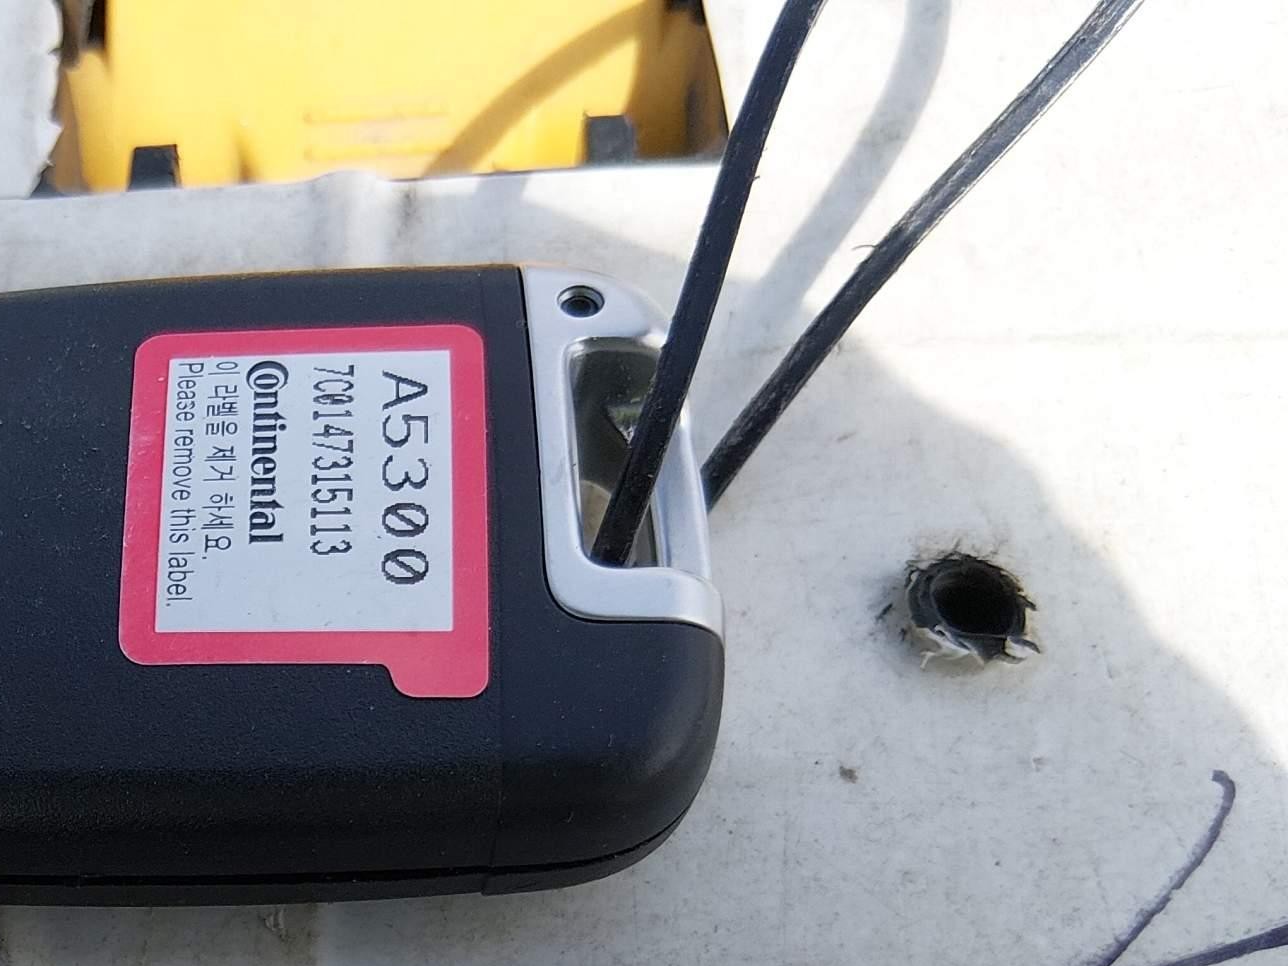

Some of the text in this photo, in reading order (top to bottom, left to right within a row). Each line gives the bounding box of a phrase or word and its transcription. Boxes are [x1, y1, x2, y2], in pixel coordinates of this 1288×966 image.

[166, 362, 203, 607] Please remove this label.
[202, 362, 239, 560] 이 라벨을 제거 하세요.
[246, 361, 289, 544] Continental
[382, 371, 429, 585] A5300
